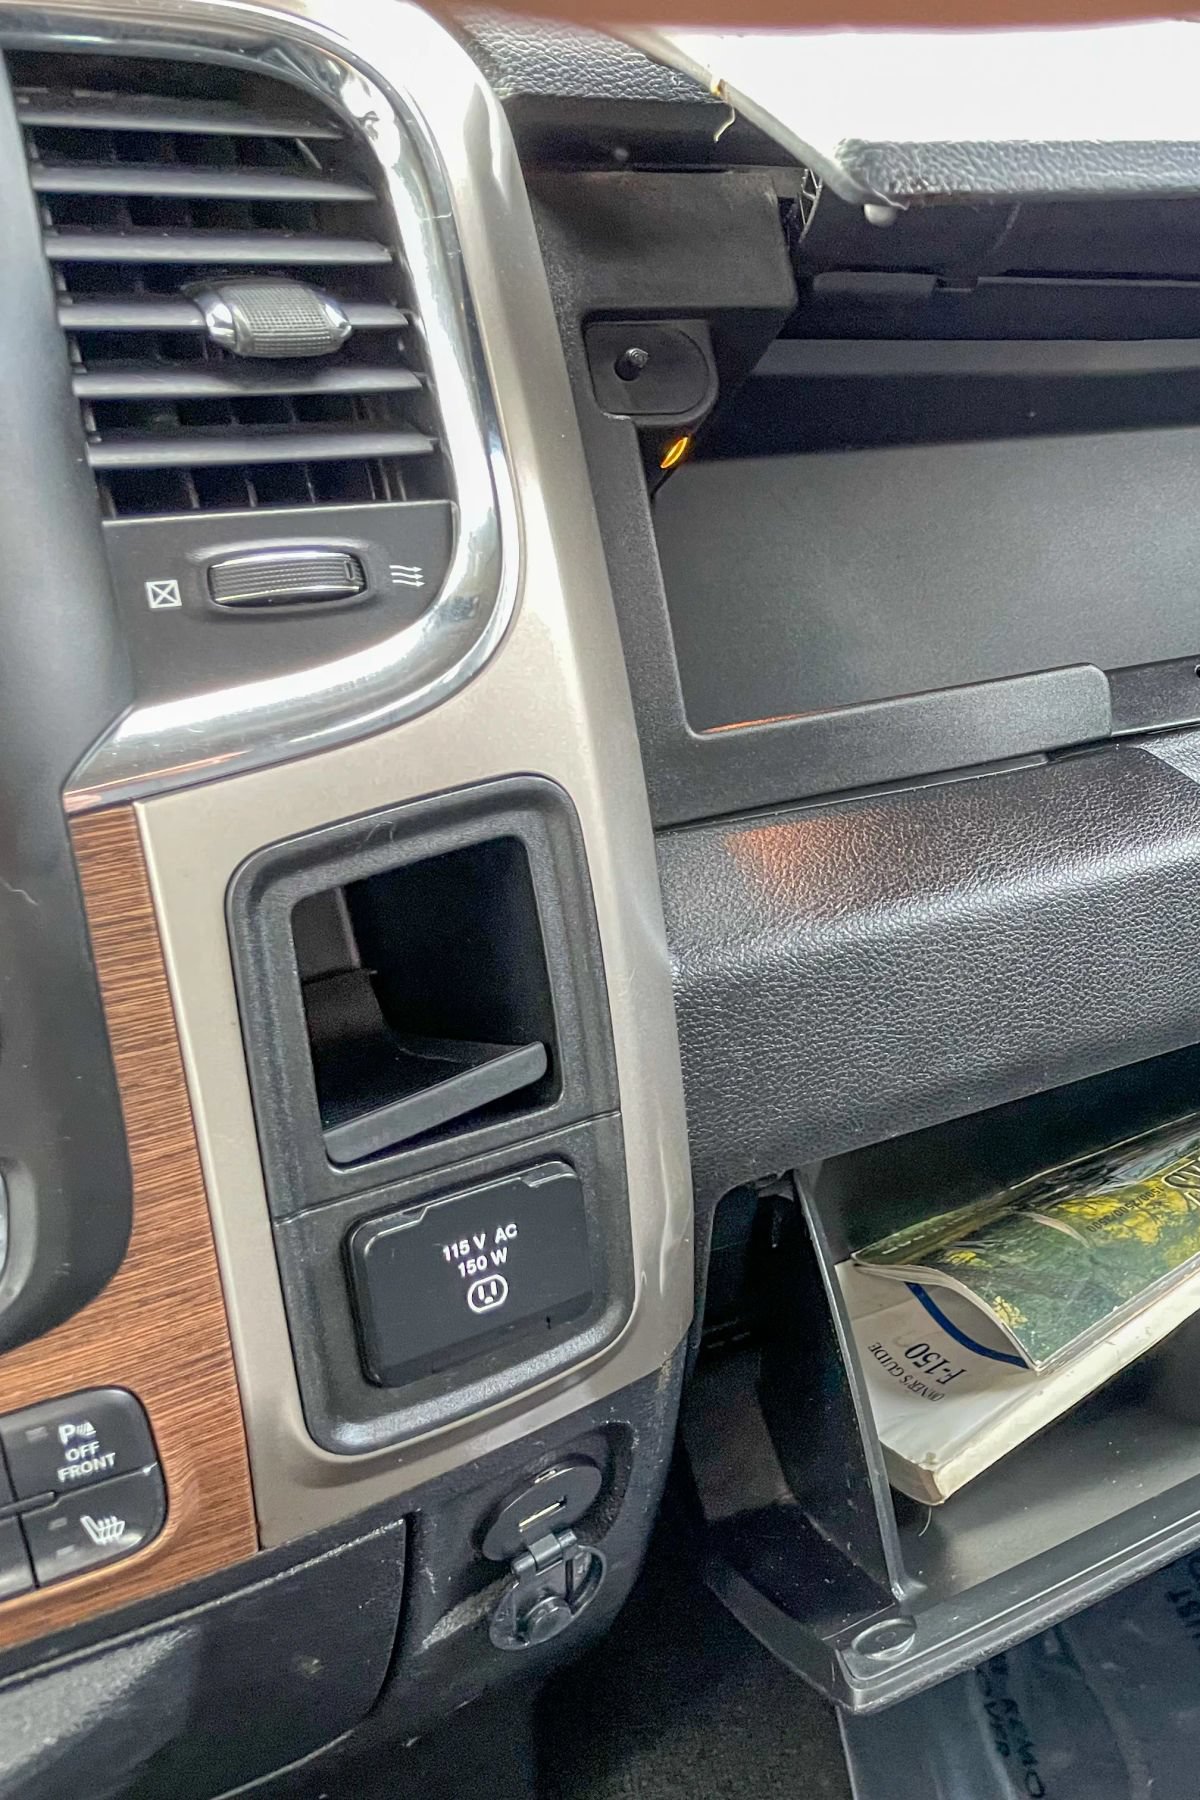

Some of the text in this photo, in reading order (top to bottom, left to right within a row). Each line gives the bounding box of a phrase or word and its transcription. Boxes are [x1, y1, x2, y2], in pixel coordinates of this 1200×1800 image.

[1086, 1185, 1166, 1233] 1500/2500/3500
[442, 1223, 518, 1262] 115 V AC
[457, 1246, 508, 1278] 150 W
[867, 1342, 945, 1402] OWNER'S GUIDE
[904, 1343, 967, 1385] F-150
[57, 1452, 116, 1483] FRONT
[65, 1440, 100, 1462] OFF
